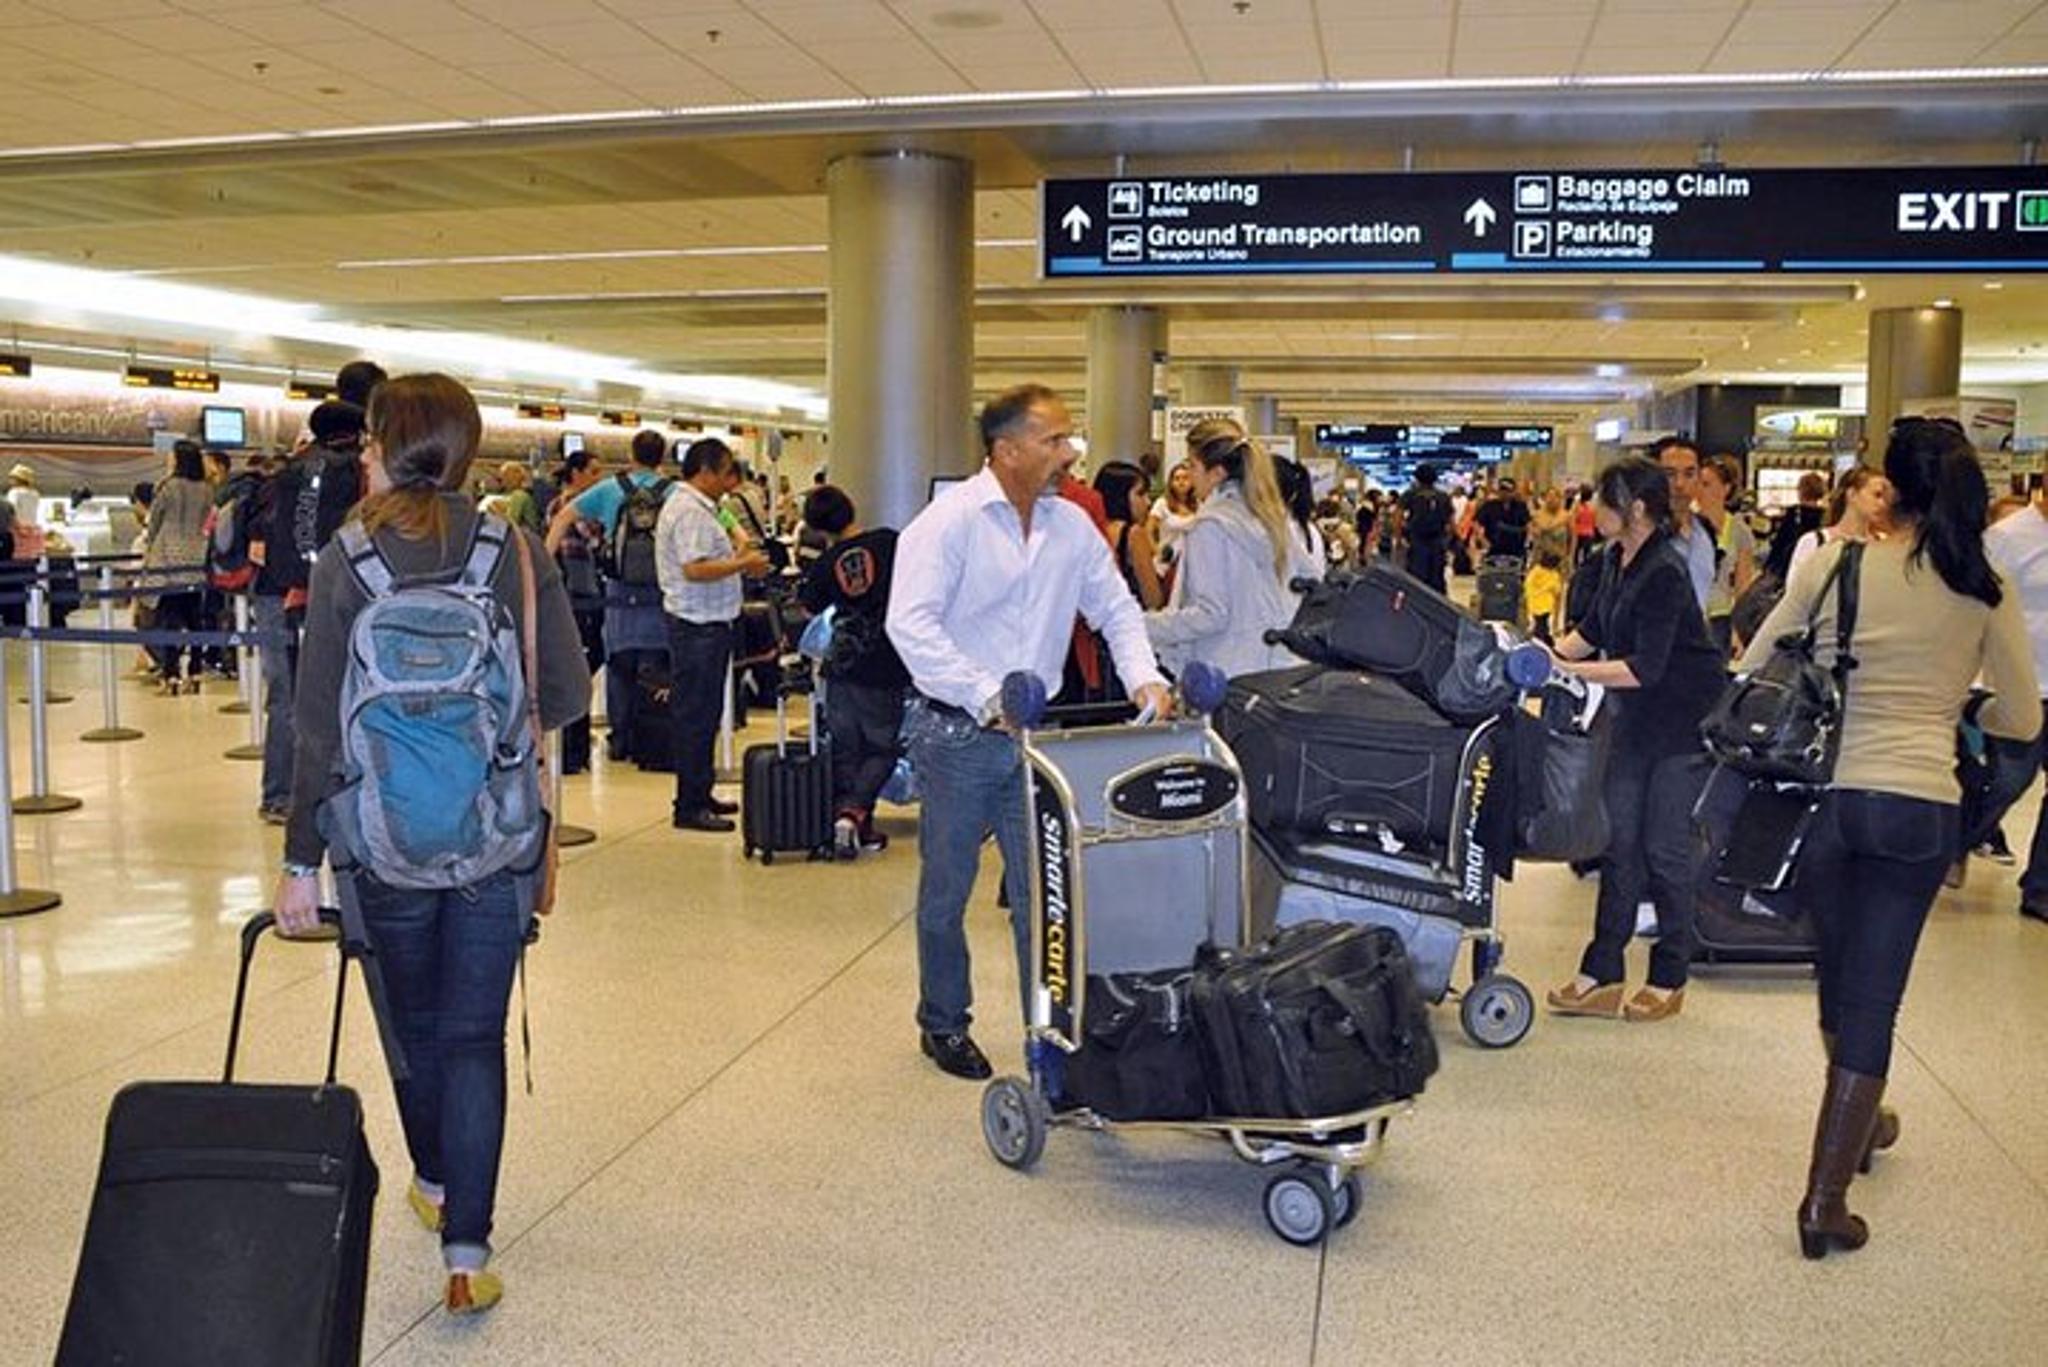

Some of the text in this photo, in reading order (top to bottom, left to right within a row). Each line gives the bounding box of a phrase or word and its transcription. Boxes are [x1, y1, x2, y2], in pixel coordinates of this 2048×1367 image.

[1148, 180, 1259, 206] Ticketing
[1557, 174, 1749, 200] Baggage Claim
[1899, 193, 2010, 230] EXIT
[1148, 222, 1420, 248] Ground Transportation
[1557, 221, 1653, 246] Parking
[0, 408, 100, 434] merican
